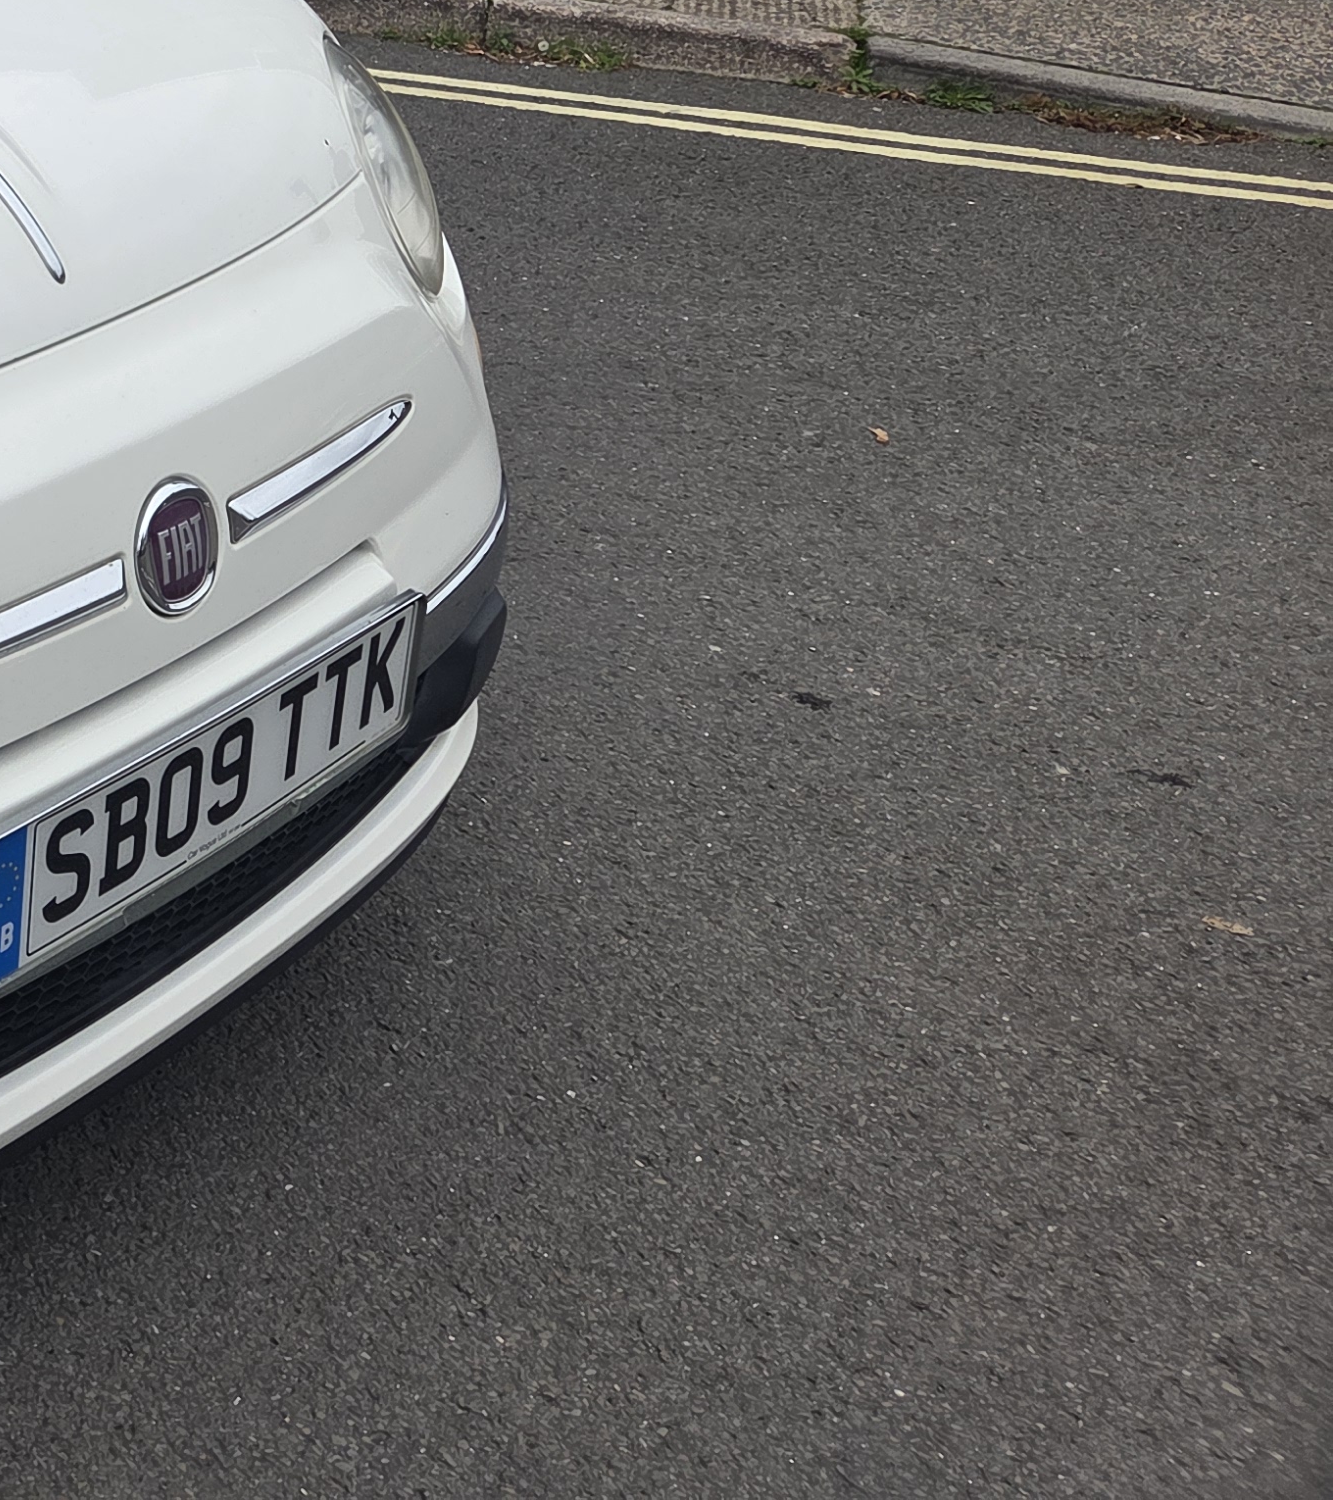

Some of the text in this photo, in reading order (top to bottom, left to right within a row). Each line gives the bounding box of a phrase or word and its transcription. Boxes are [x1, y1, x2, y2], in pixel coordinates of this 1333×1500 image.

[157, 511, 202, 587] FIAT
[41, 616, 407, 924] SB09 TTK
